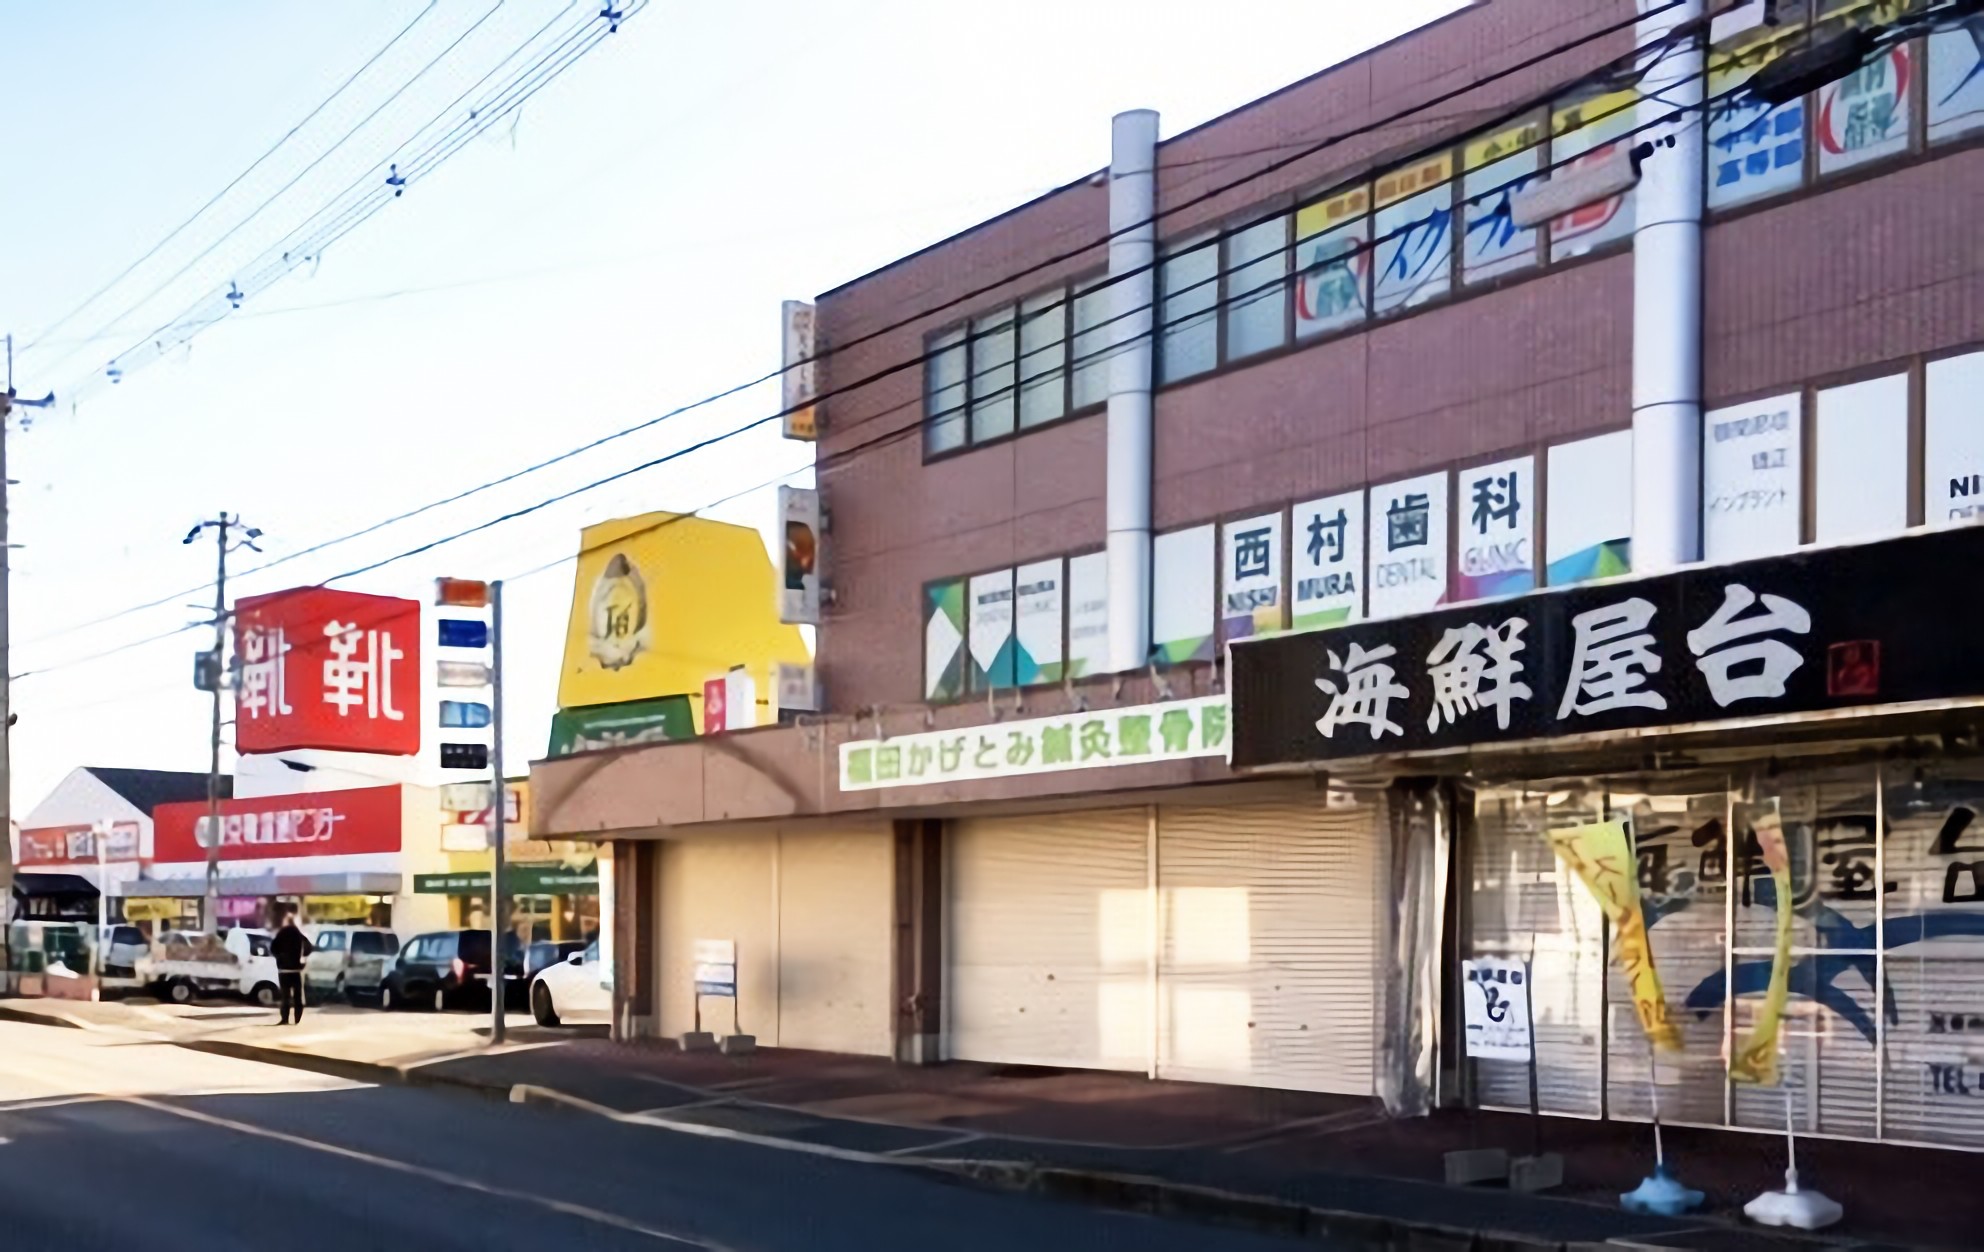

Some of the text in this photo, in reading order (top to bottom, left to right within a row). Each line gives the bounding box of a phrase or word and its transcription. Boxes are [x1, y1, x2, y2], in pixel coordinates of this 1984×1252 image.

[1234, 471, 1520, 580] 西村歯科
[1297, 571, 1356, 602] MURA
[322, 619, 405, 722] 靴
[1314, 583, 1813, 741] 海鮮屋台
